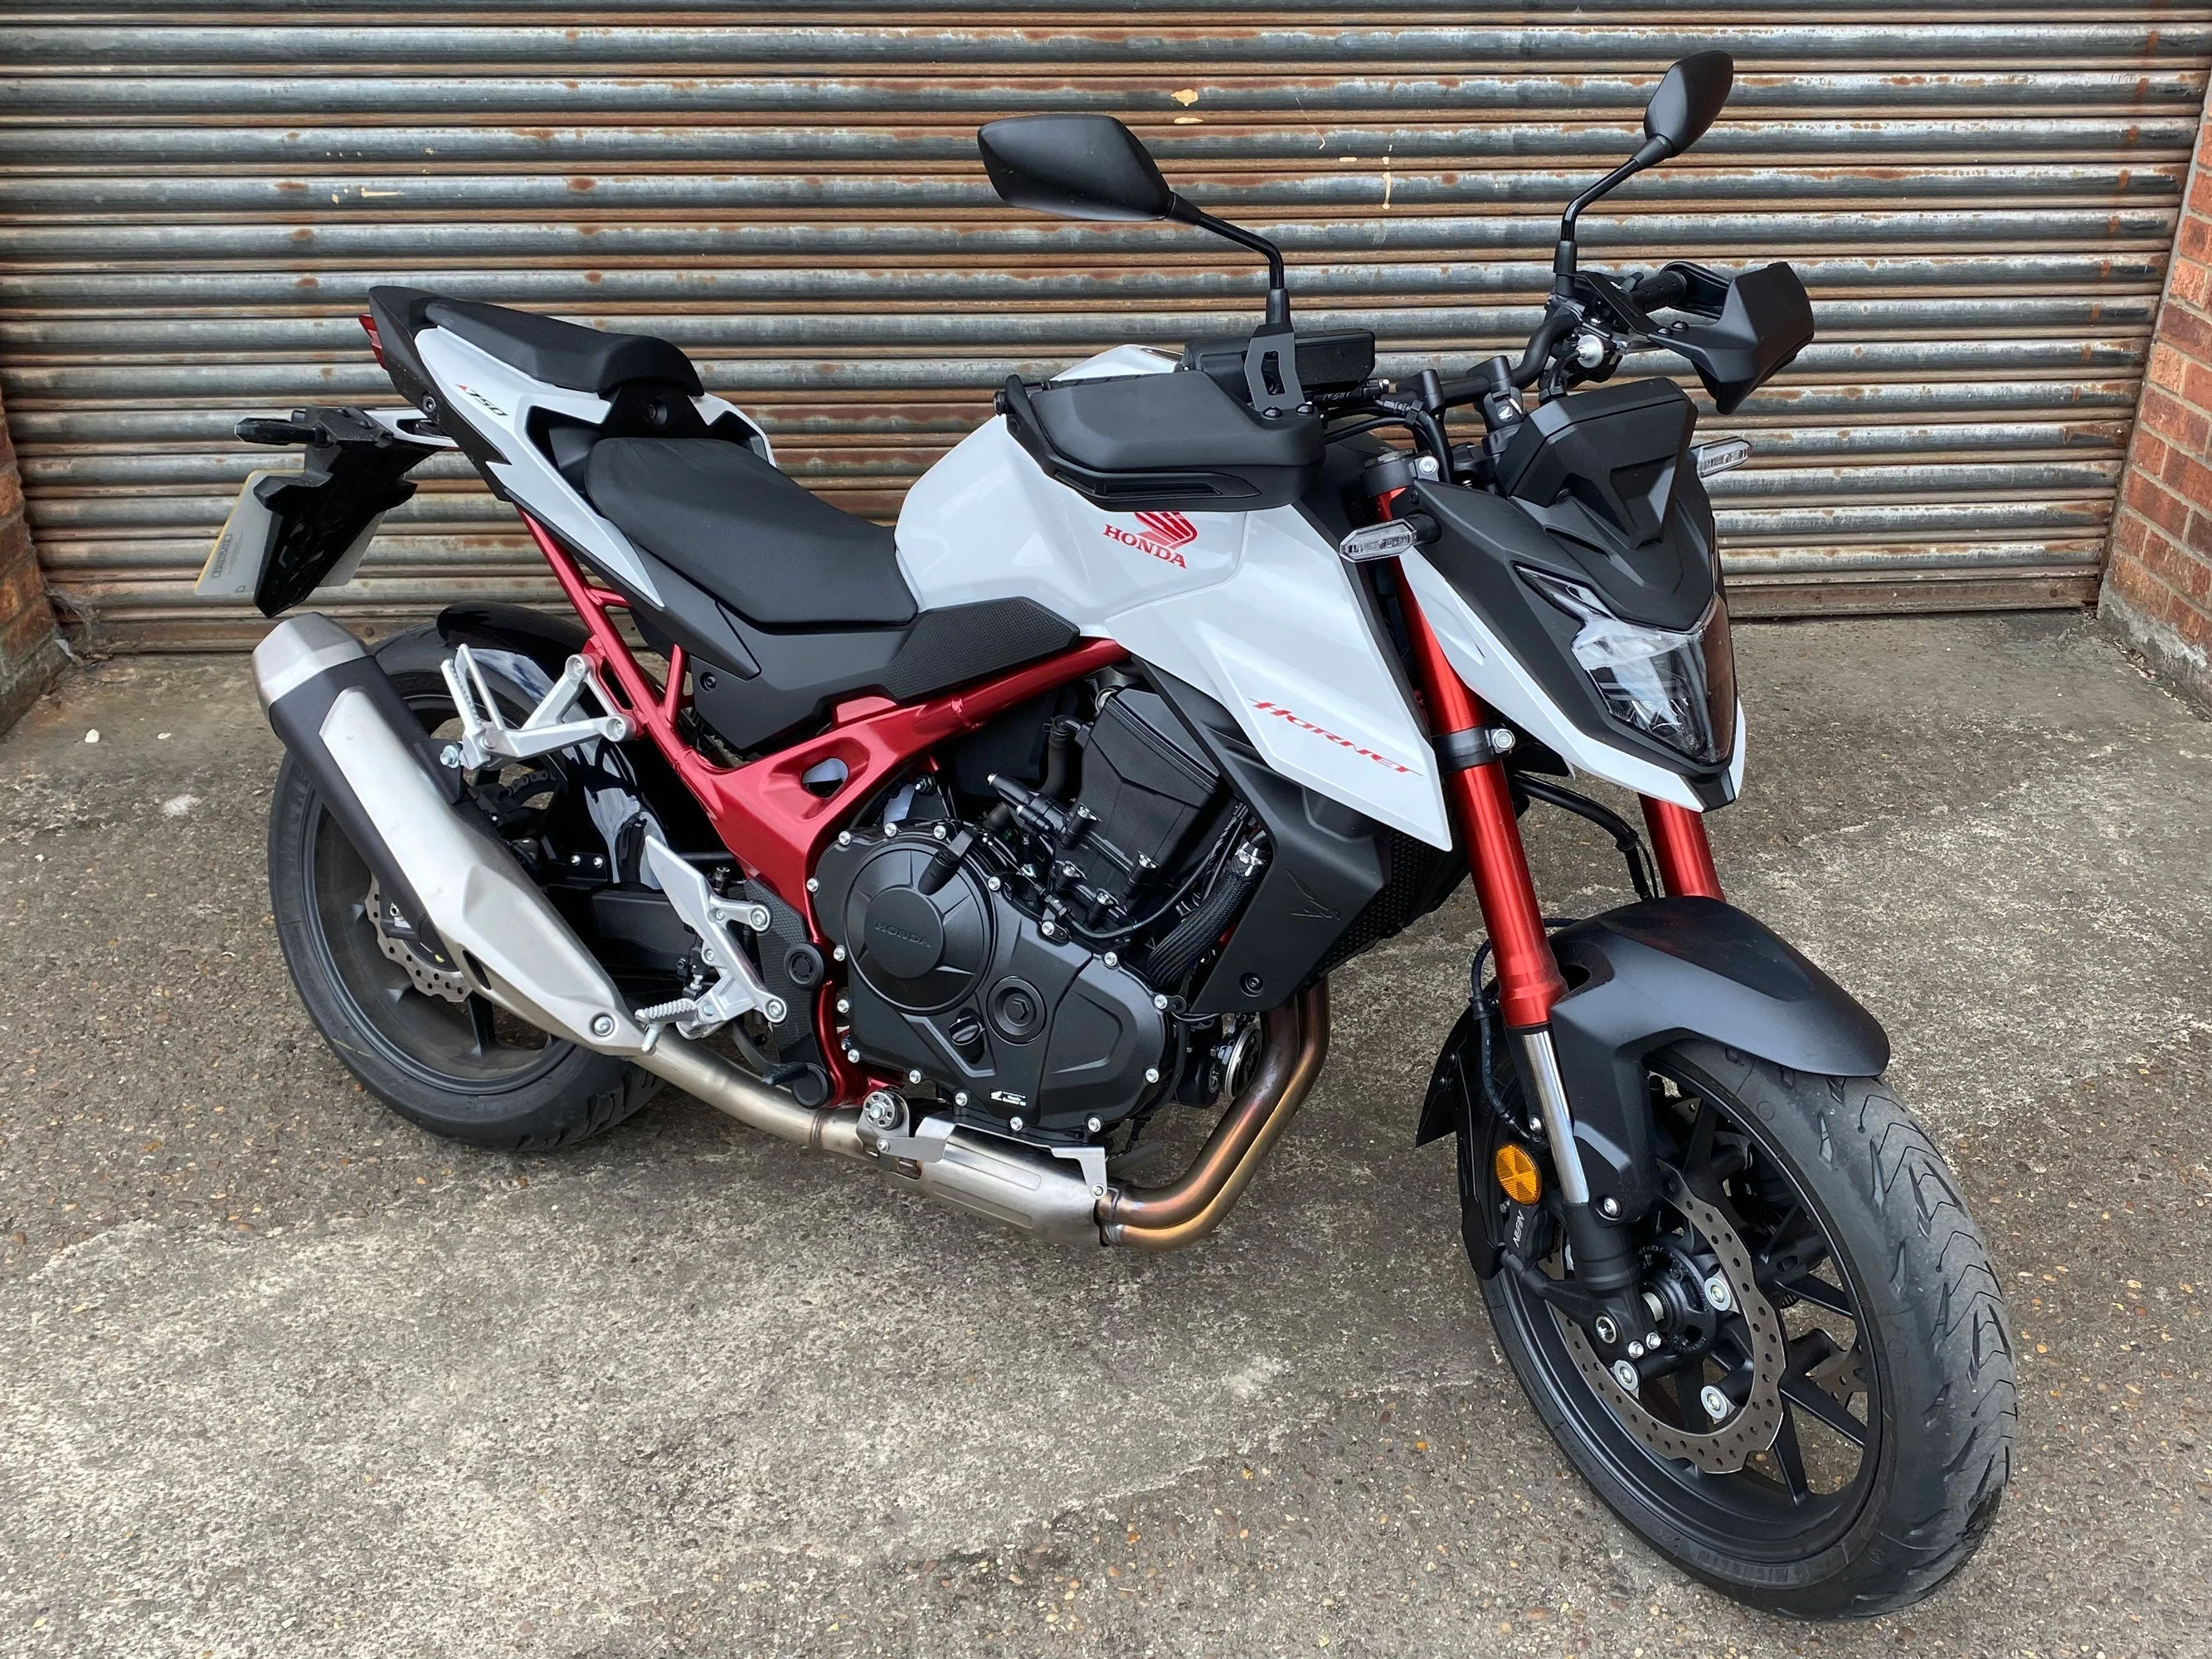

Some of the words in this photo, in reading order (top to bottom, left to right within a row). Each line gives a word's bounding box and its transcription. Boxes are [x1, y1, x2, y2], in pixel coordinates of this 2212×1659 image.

[1102, 523, 1187, 570] HONDA
[1249, 698, 1425, 777] HORNET
[873, 921, 932, 949] HONDA
